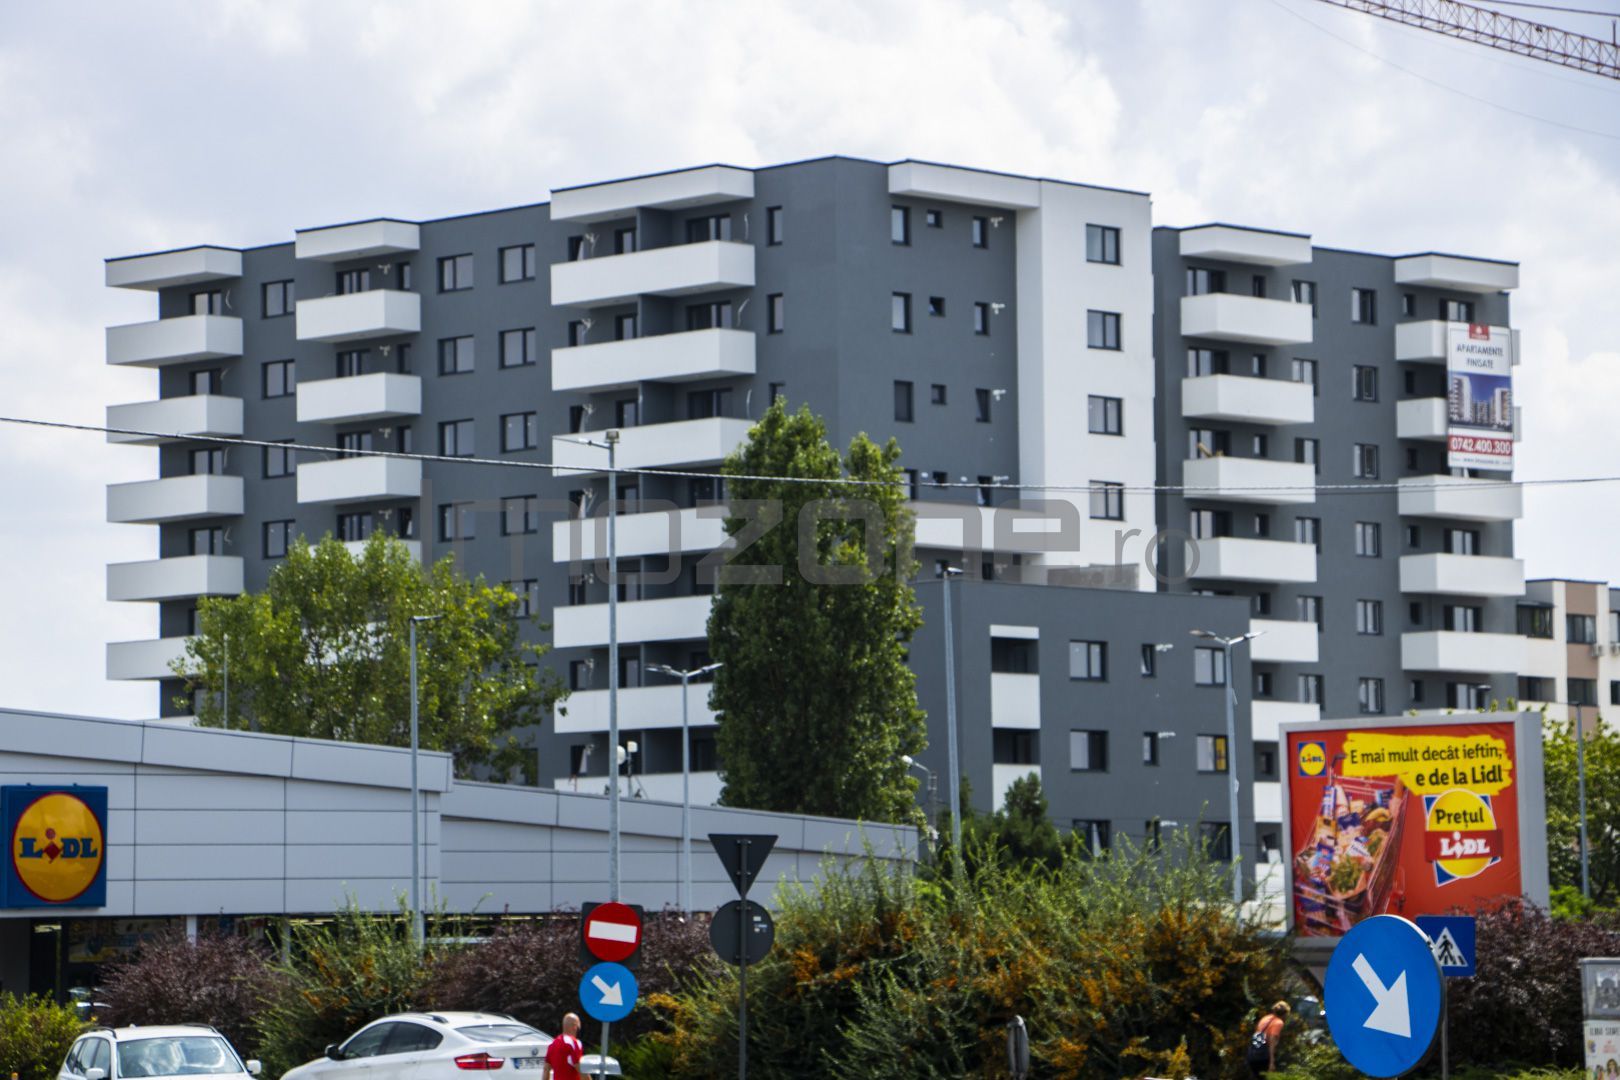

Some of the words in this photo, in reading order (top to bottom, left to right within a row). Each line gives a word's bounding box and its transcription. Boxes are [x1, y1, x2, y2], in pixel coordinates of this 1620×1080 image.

[1456, 343, 1503, 357] APARTAMENTE
[1451, 436, 1511, 454] 0742.400.300
[1361, 748, 1385, 763] mai
[1388, 747, 1419, 762] mult
[1422, 745, 1460, 761] decât
[1462, 742, 1503, 760] ieftin,
[1415, 773, 1425, 786] e
[1428, 768, 1449, 786] de
[1453, 767, 1468, 785] la
[1471, 765, 1503, 784] Lidl
[1435, 806, 1485, 828] Prețul
